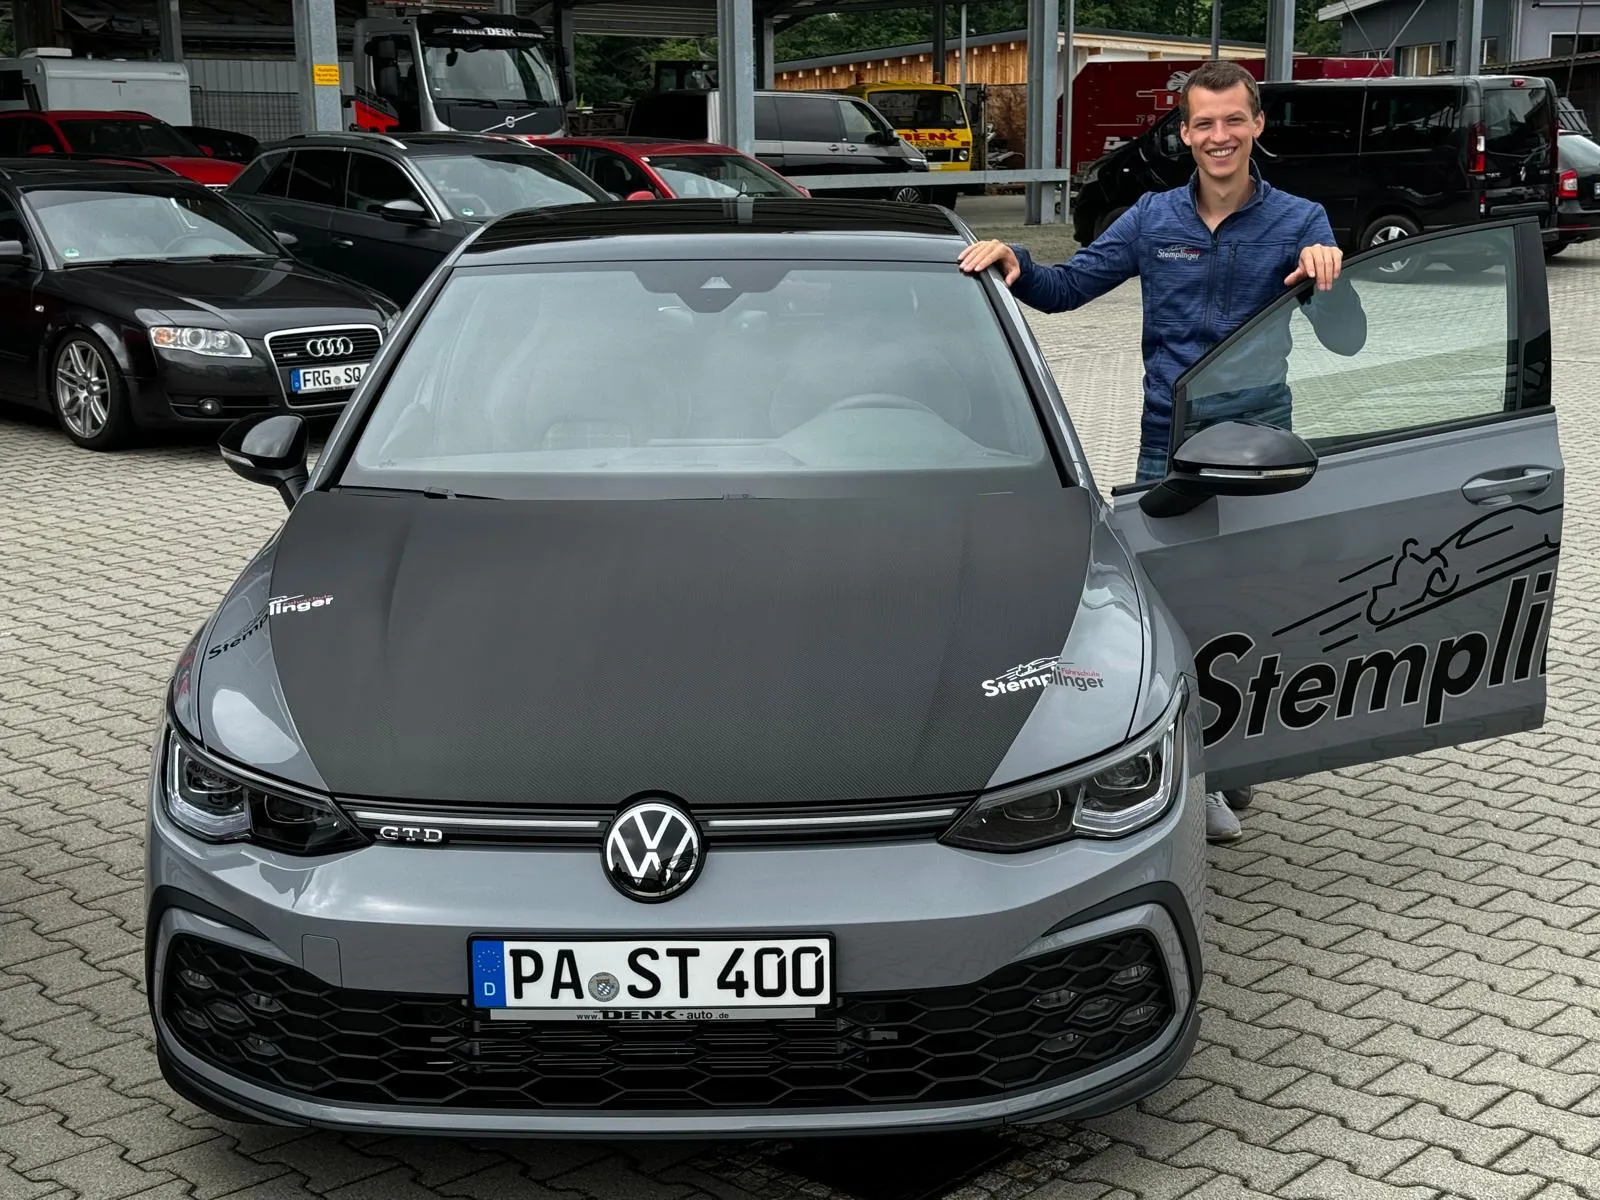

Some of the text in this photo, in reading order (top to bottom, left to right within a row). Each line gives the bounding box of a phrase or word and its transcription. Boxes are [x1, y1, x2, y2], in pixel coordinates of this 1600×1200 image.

[1157, 248, 1201, 260] Stemplinger
[302, 370, 332, 387] FRG
[1194, 569, 1556, 749] Stempli
[981, 666, 1104, 697] Stemplinger
[380, 826, 443, 842] GTD
[484, 982, 496, 996] D
[509, 949, 584, 999] PA
[627, 947, 700, 999] ST
[717, 946, 824, 998] 400
